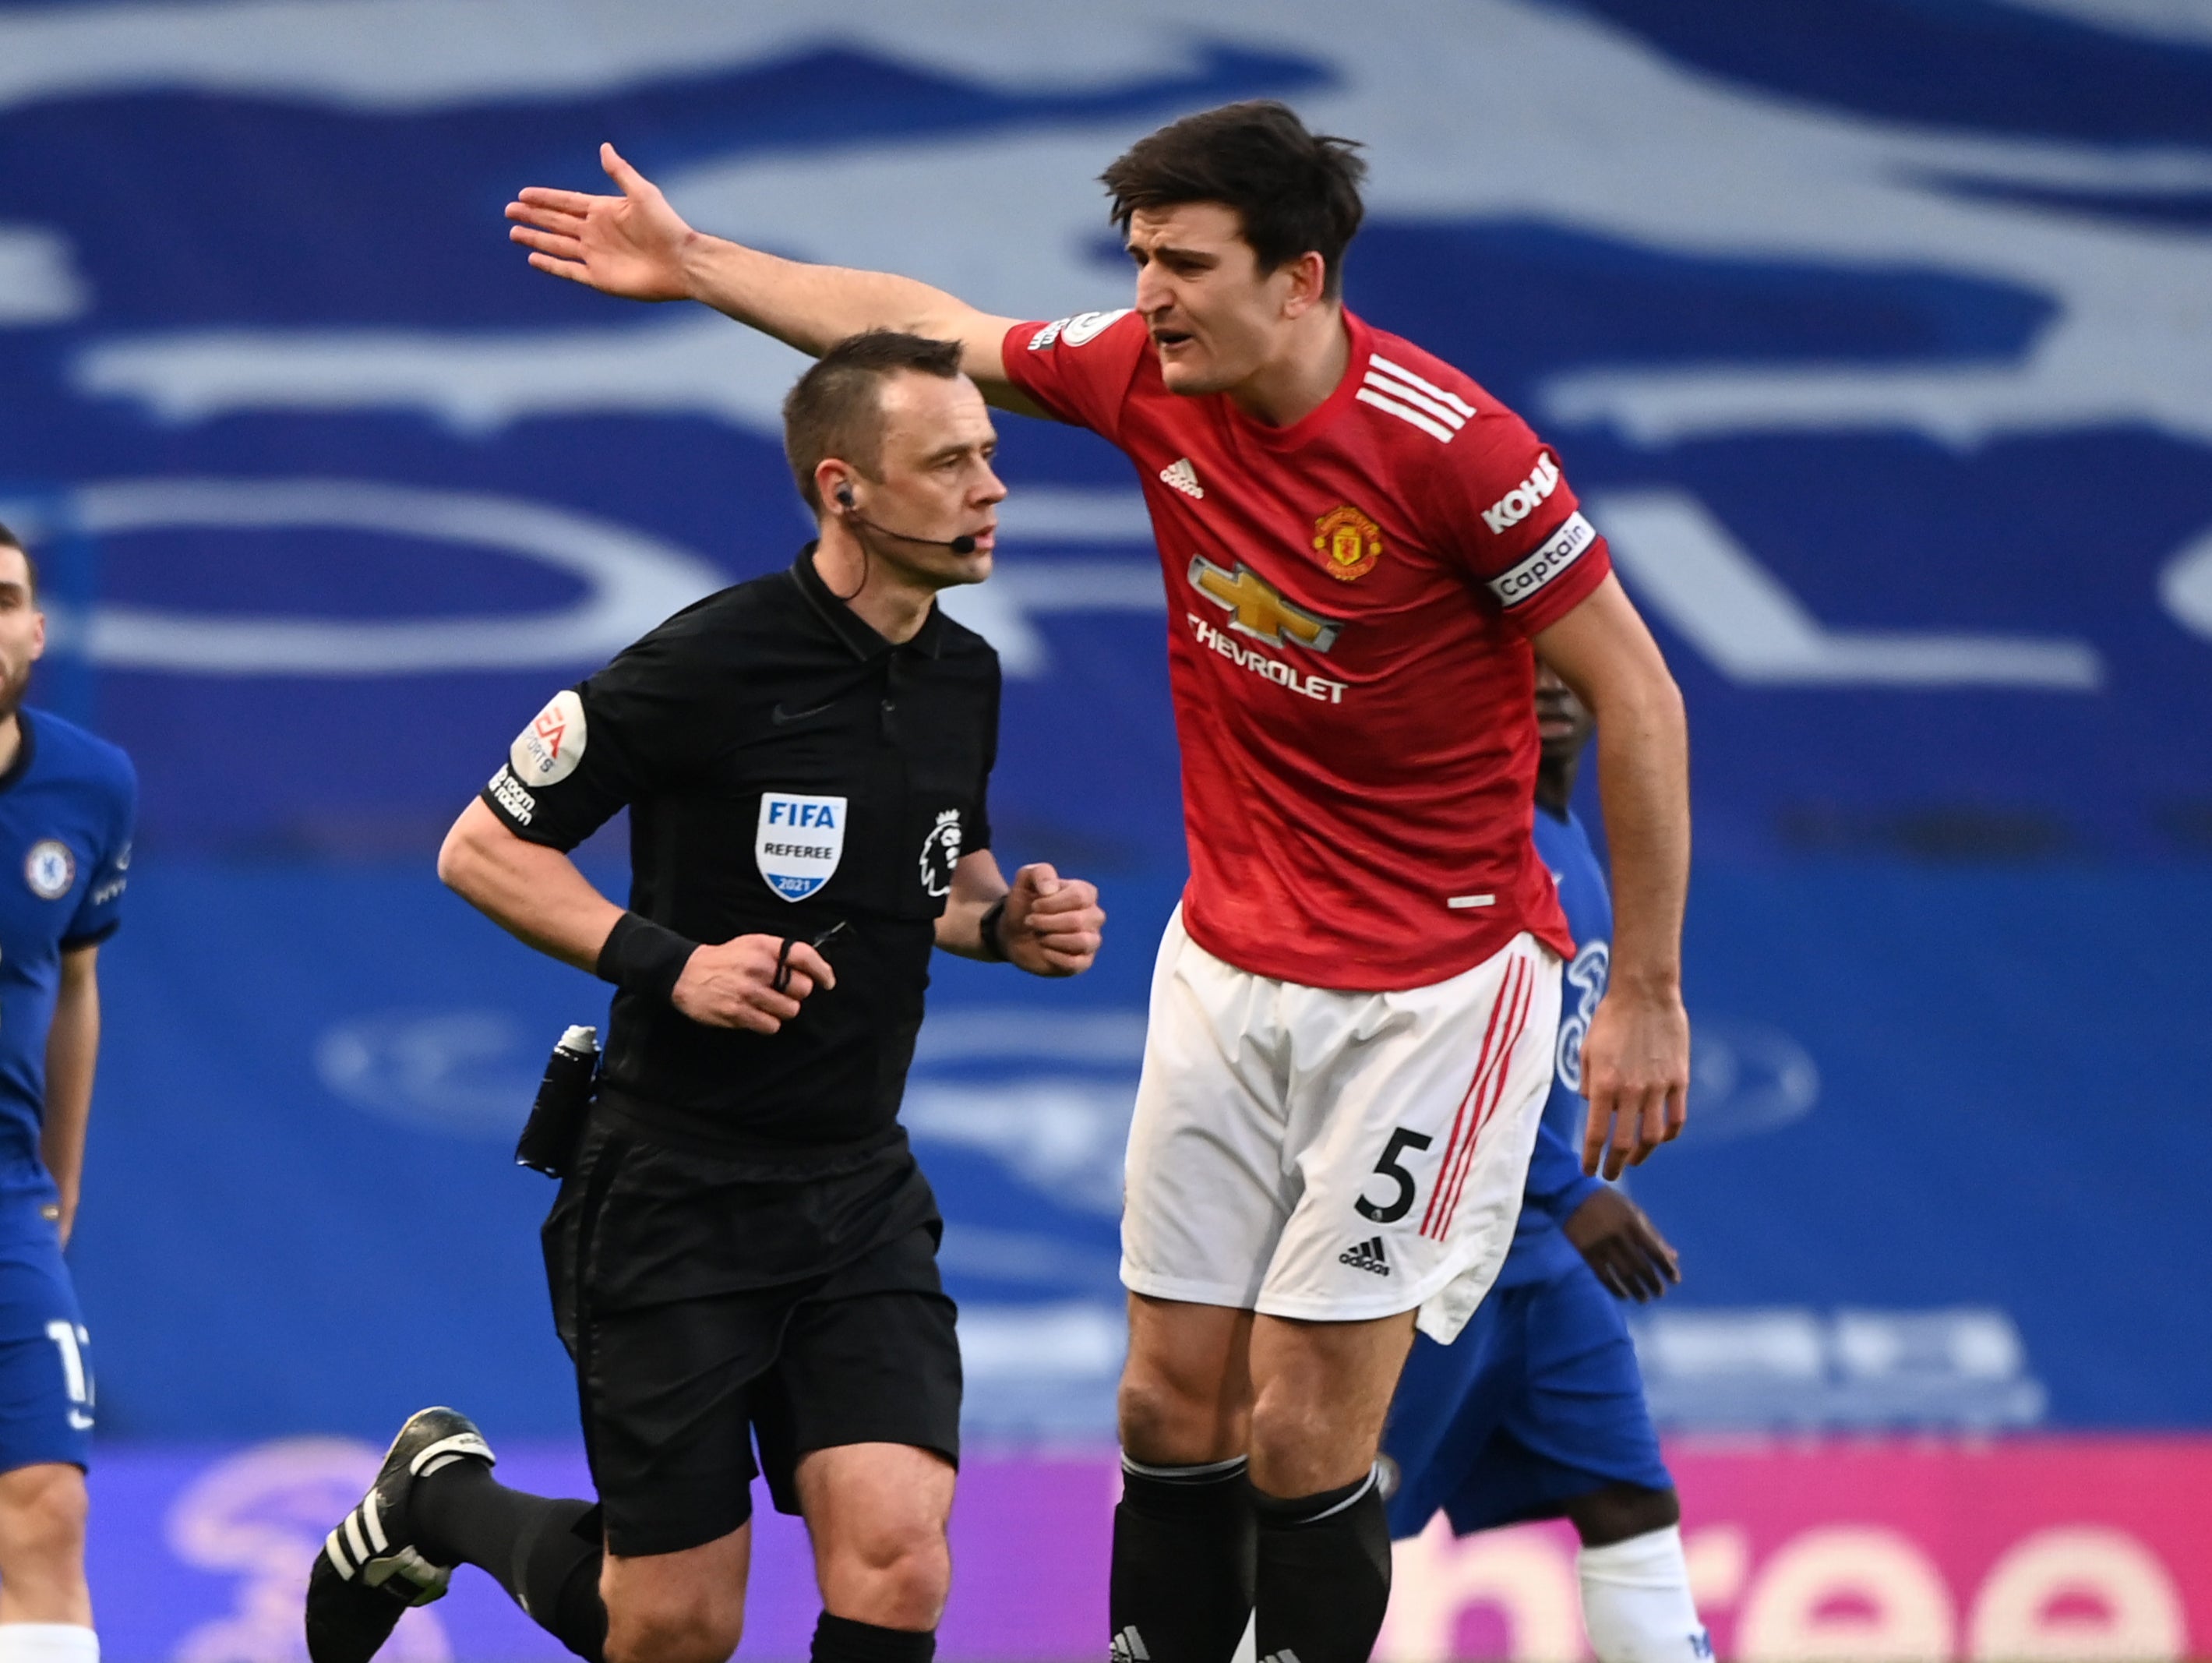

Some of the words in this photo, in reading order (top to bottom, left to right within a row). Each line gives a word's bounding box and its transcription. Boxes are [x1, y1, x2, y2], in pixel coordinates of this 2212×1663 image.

[1500, 524, 1587, 596] Captain
[535, 706, 566, 759] EA
[521, 729, 554, 773] PORTS
[768, 801, 835, 828] FIFA
[764, 842, 833, 860] REFEREE
[778, 877, 811, 892] 2021
[1353, 1126, 1434, 1224] 5
[1339, 1252, 1390, 1276] adidas
